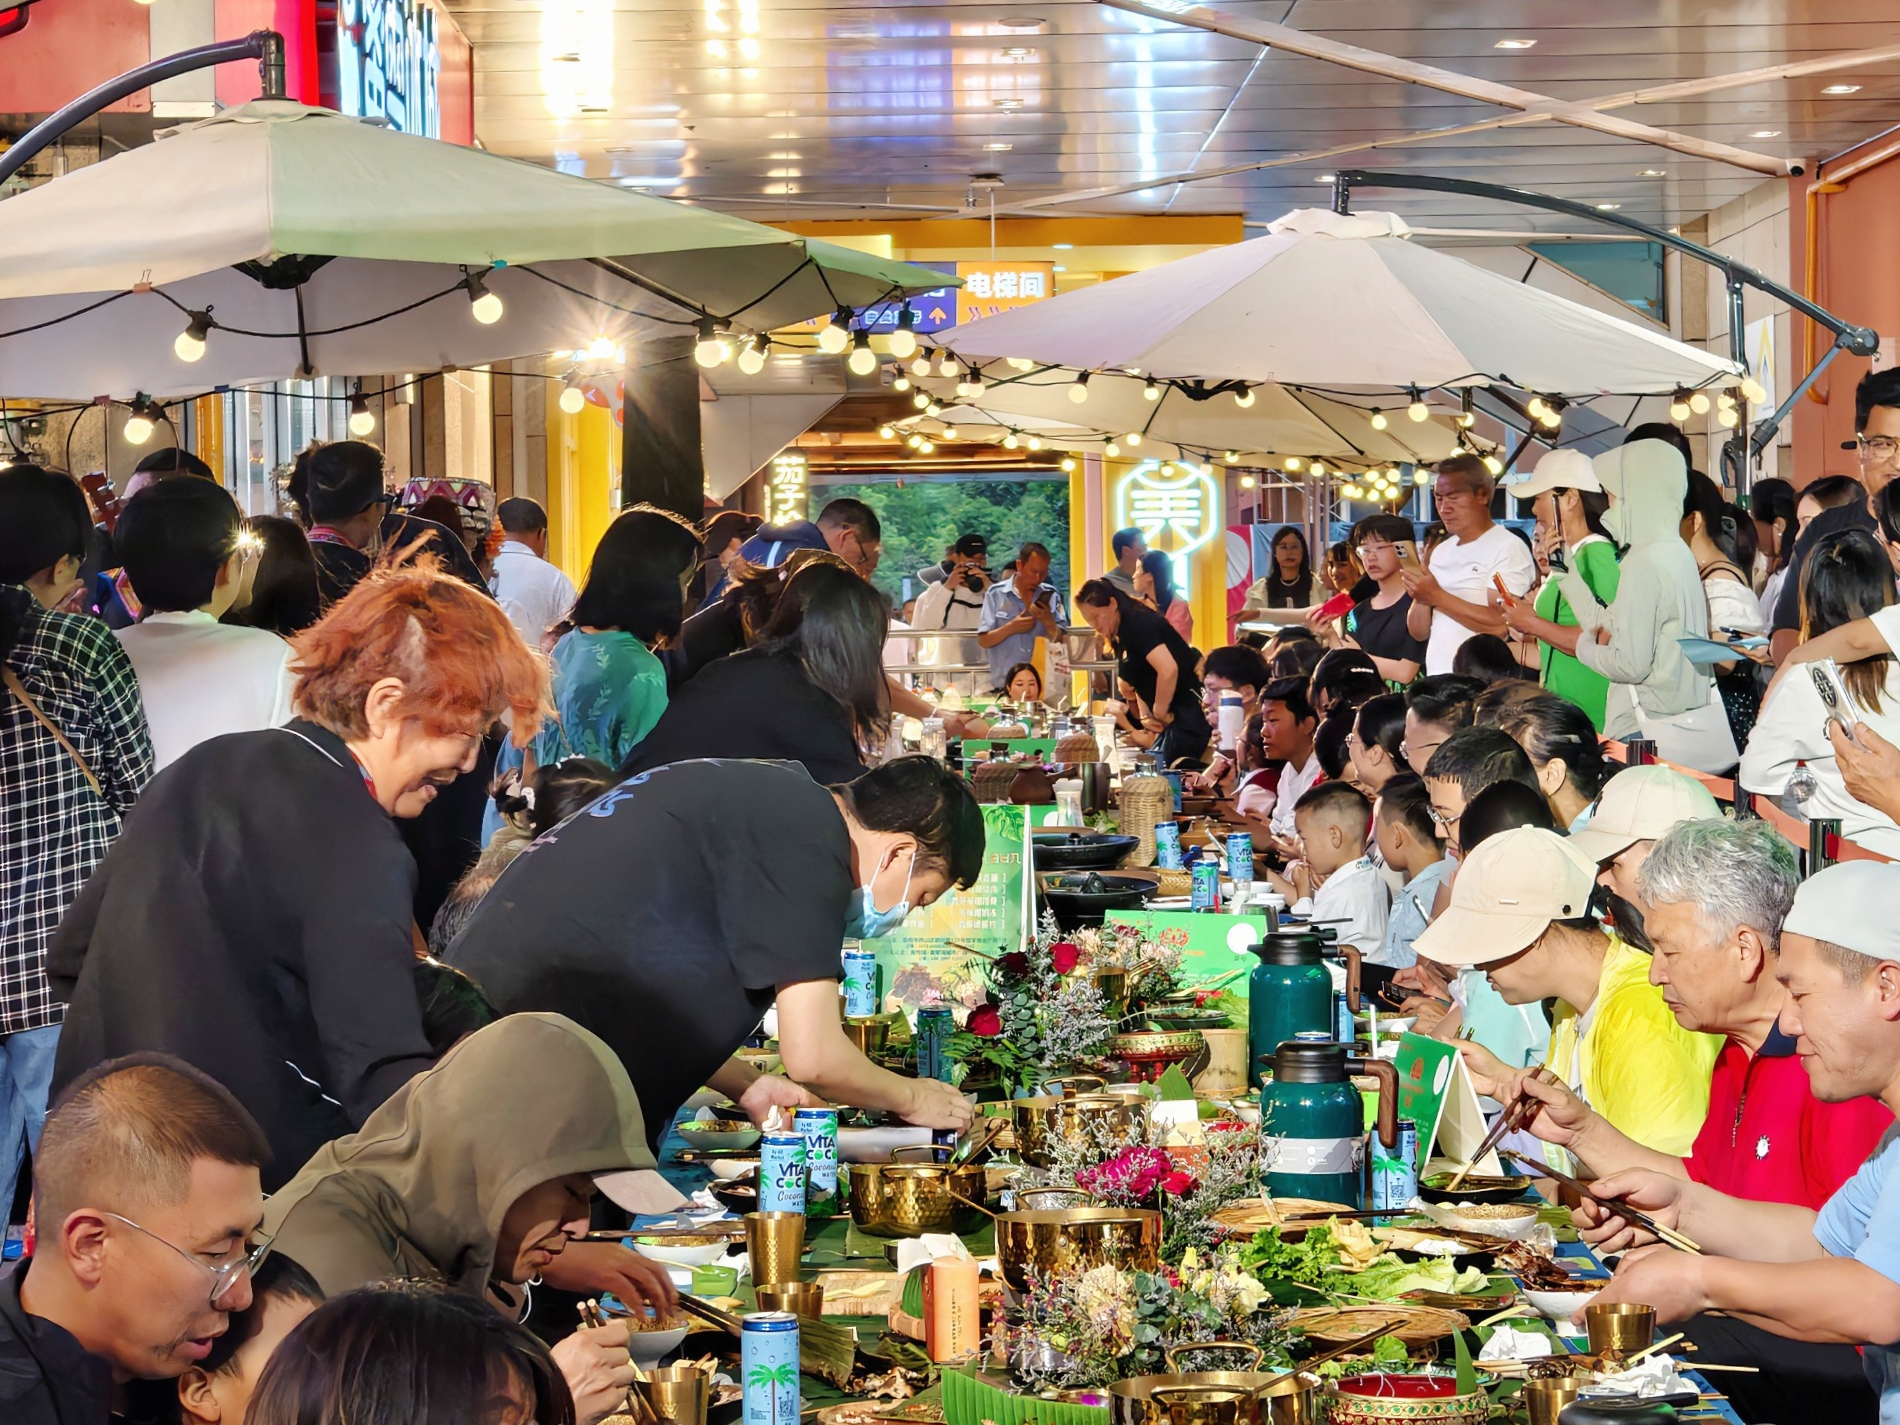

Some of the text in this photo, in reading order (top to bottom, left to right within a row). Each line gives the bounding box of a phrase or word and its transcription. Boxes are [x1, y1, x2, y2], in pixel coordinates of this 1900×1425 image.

[967, 271, 1045, 299] 电梯间
[808, 1134, 836, 1149] VITA
[779, 1161, 805, 1177] VITA
